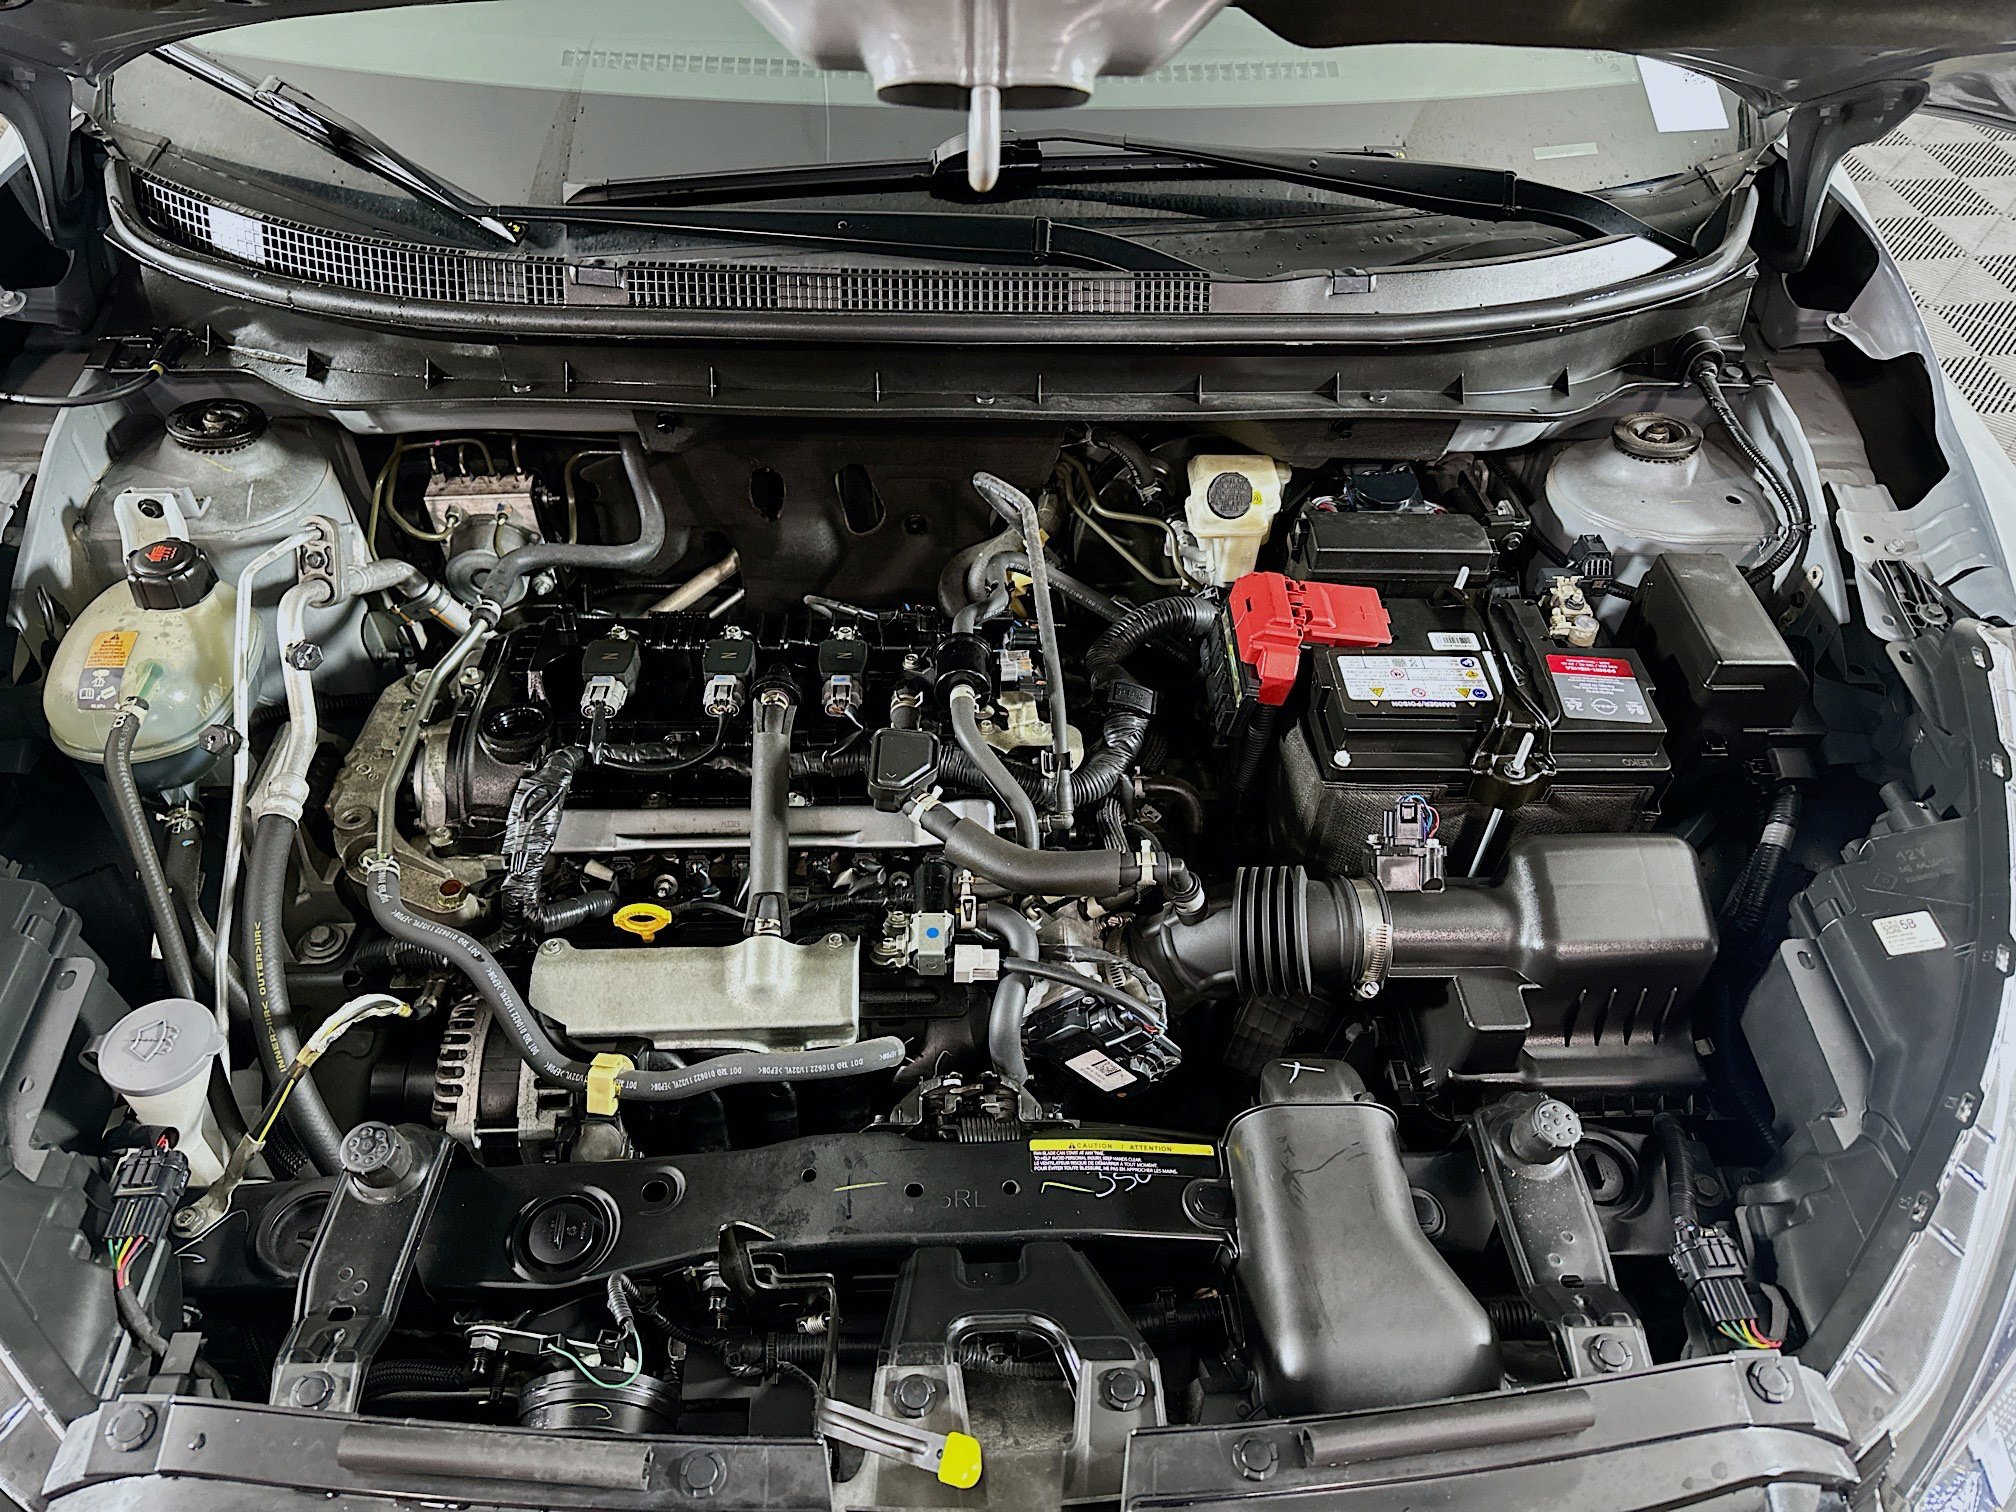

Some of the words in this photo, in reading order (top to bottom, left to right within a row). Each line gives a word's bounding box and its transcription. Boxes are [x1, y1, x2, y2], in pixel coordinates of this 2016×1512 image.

[196, 676, 228, 717] MAX
[1896, 847, 1926, 860] 12V
[1900, 918, 1917, 930] 5B
[467, 944, 481, 957] DOT
[254, 921, 267, 996] OUTER>IIR<
[511, 1011, 527, 1034] 010622
[527, 1042, 540, 1056] DOT
[810, 1063, 835, 1073] 010622
[850, 1058, 864, 1068] DOT
[694, 1070, 716, 1083] 010622
[730, 1067, 742, 1075] DOT
[625, 1081, 637, 1089] DOT
